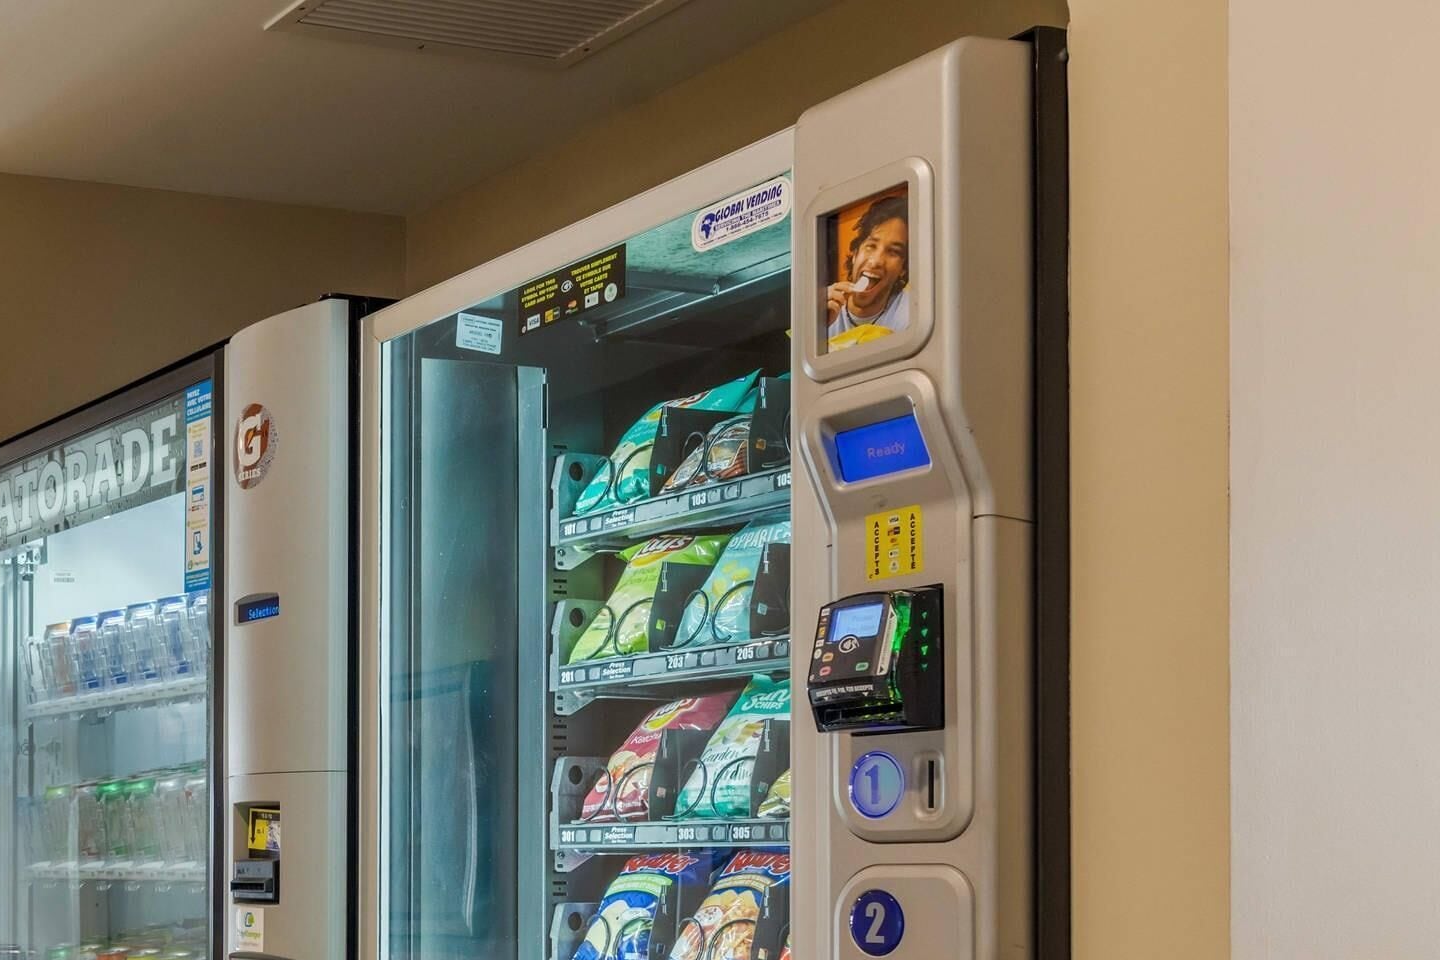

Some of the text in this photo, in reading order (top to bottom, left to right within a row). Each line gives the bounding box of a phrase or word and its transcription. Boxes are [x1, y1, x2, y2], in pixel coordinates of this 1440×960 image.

[715, 199, 745, 223] GLOBAL
[746, 184, 783, 210] VENDING
[867, 441, 905, 460] Ready
[691, 493, 707, 506] 103
[605, 514, 635, 525] Selection
[563, 524, 576, 535] 101
[737, 646, 754, 660] 205
[668, 656, 684, 669] 203
[561, 671, 574, 683] 201
[602, 667, 631, 676] Selection
[754, 701, 785, 710] CHIPS
[864, 764, 879, 805] 1
[561, 826, 750, 843] 301 303 305
[605, 832, 633, 840] Selection
[865, 902, 885, 944] 2
